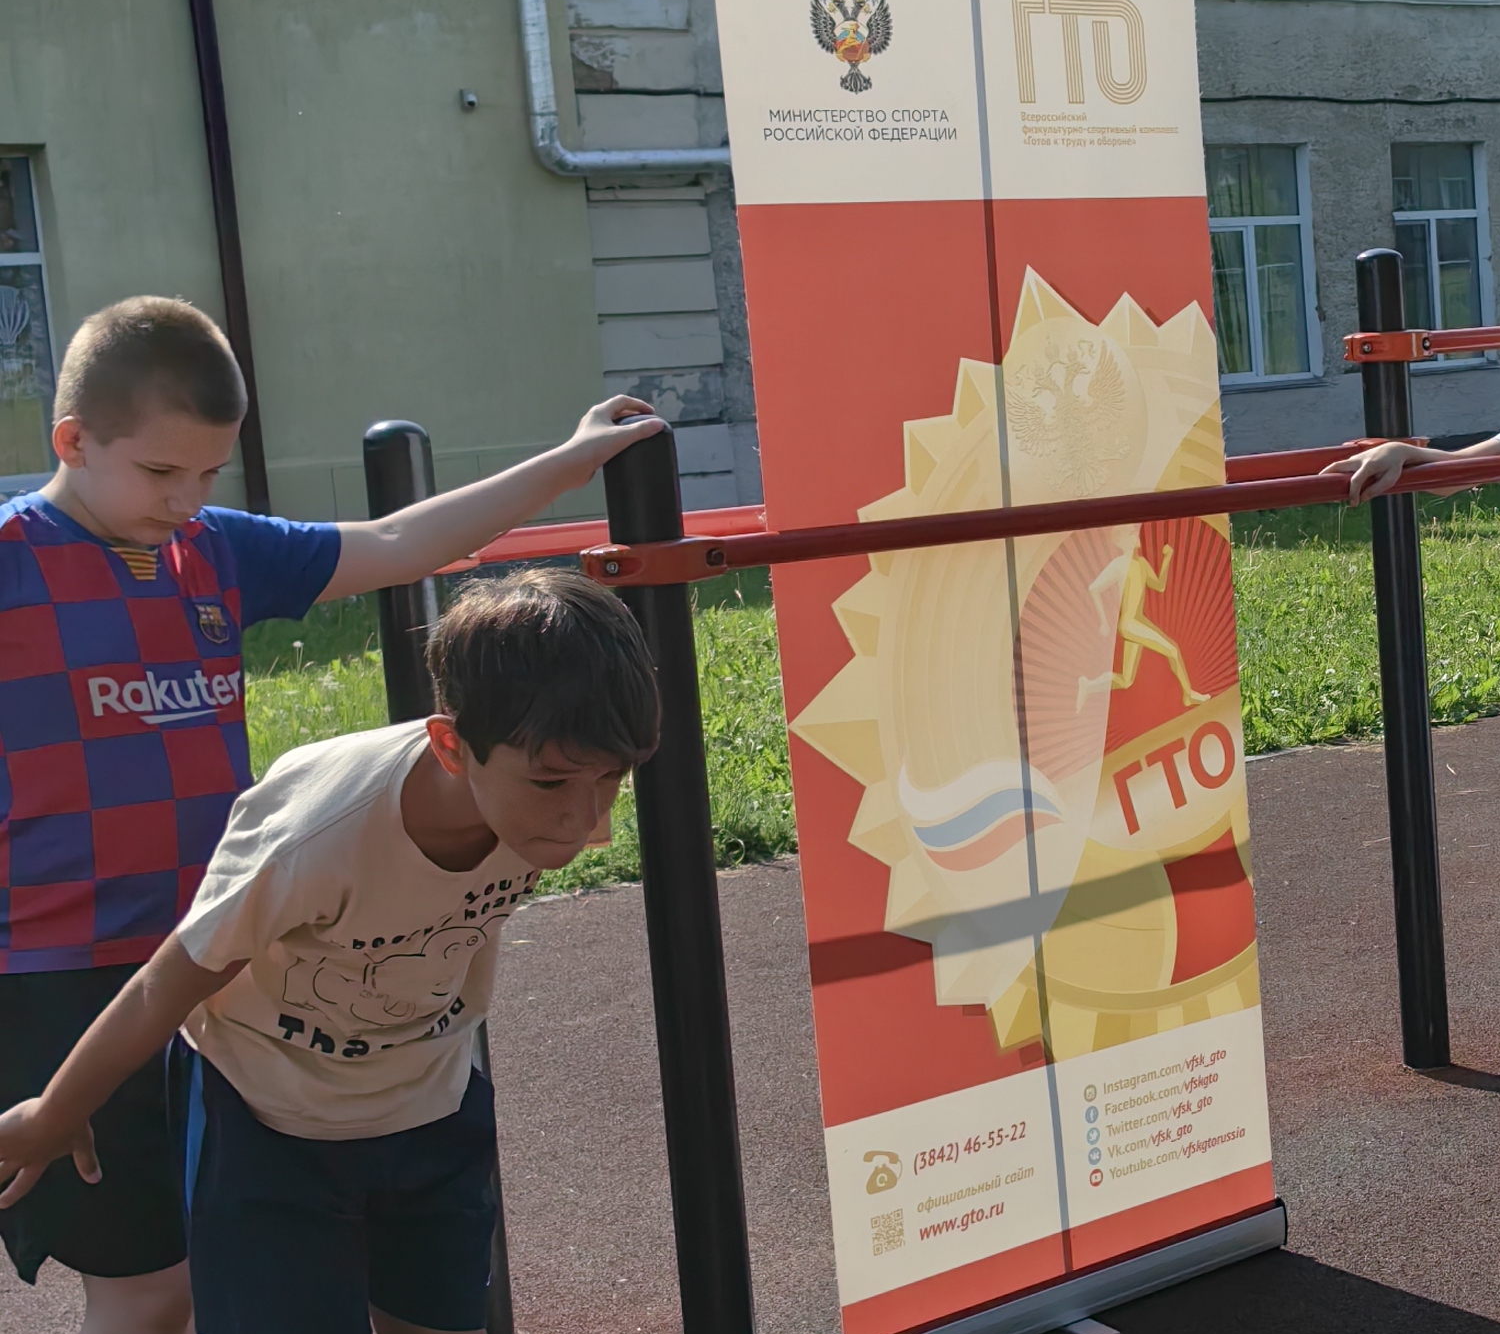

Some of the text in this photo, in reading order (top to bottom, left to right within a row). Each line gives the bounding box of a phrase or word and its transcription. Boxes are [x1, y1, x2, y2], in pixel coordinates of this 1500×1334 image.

[763, 125, 957, 142] РОССИЙСКОЙ ФЕДЕРАЦИИ
[768, 109, 949, 123] МИНИСТЕРСТВО СПОРТА
[1112, 719, 1236, 836] ГТО
[913, 1121, 1026, 1175] (3842) 46-55-22
[917, 1167, 1034, 1214] официальный сайт
[919, 1202, 1004, 1241] www.gto.ru
